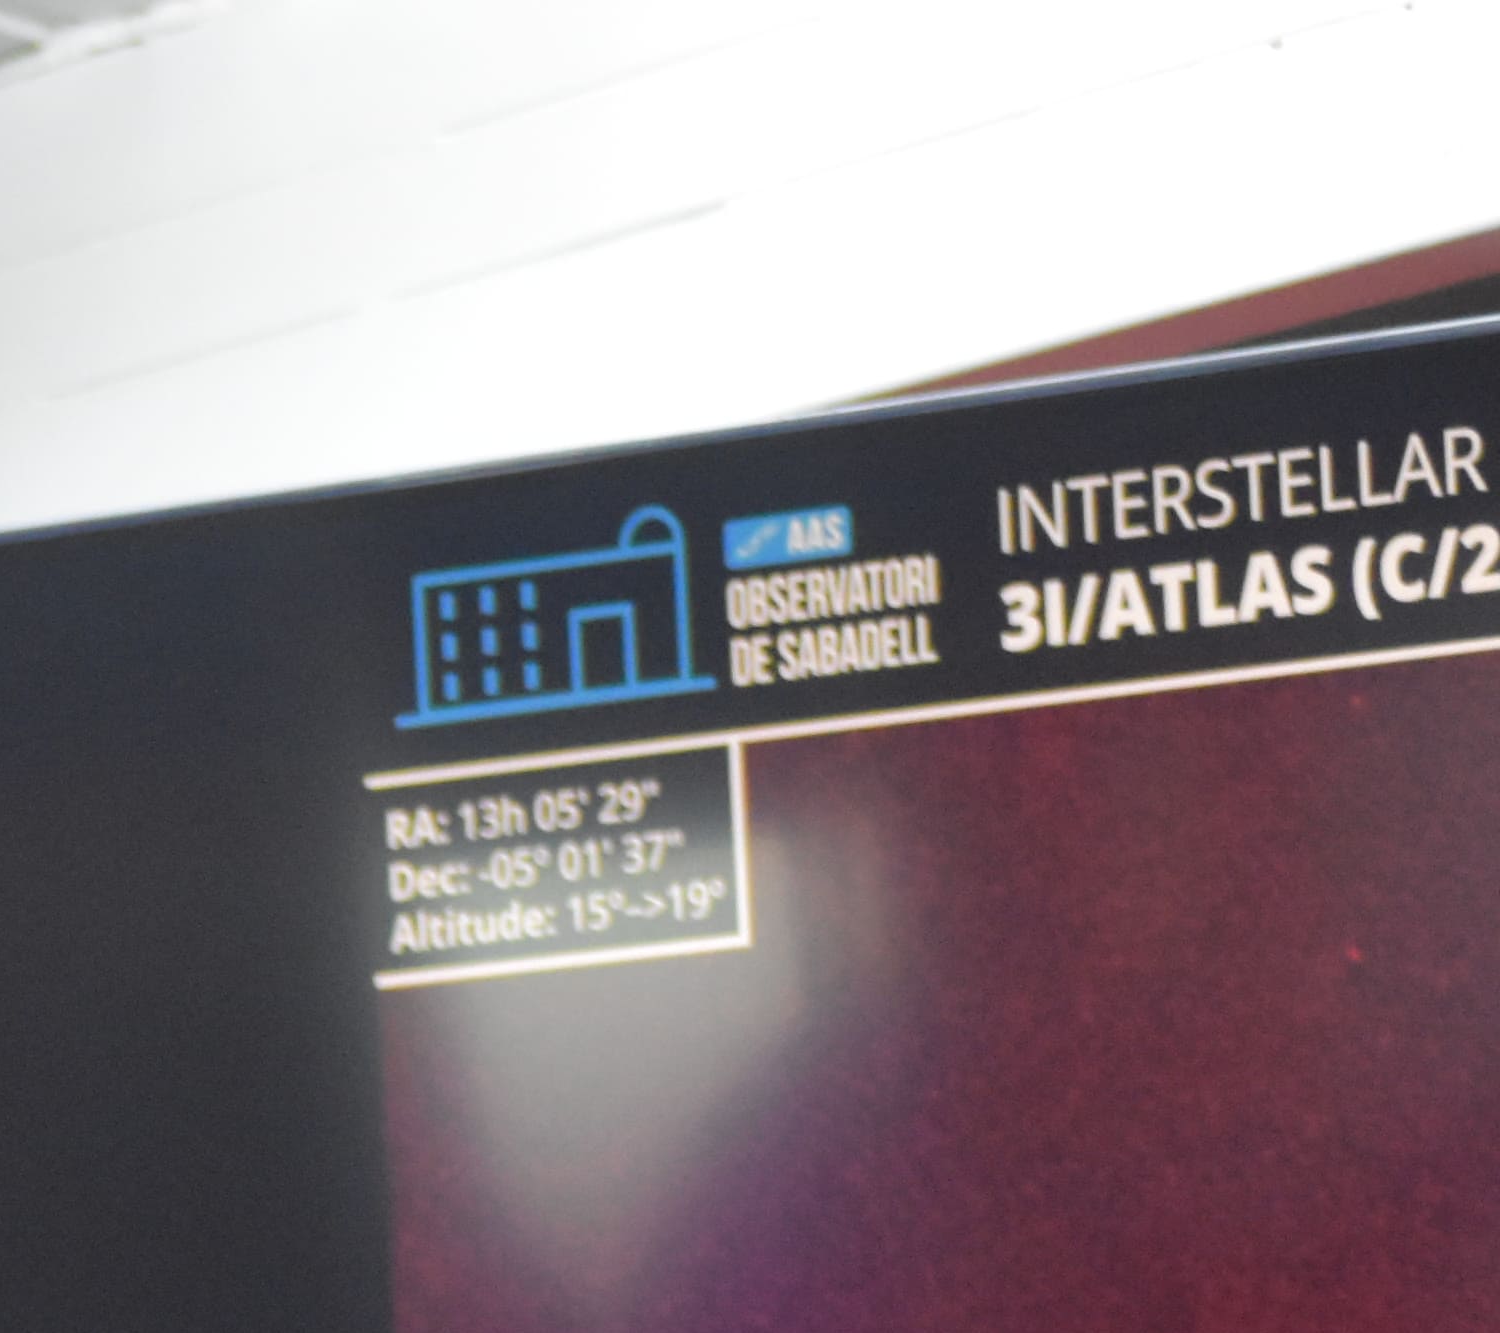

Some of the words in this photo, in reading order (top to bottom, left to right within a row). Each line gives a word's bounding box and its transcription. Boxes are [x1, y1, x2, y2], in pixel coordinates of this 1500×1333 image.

[997, 426, 1489, 556] INTERSTELLAR
[787, 512, 845, 555] AAS
[726, 553, 941, 631] OBSERVATORI
[999, 544, 1335, 654] 3I/ATLAS
[1352, 522, 1500, 621] (C/2
[730, 633, 775, 688] DE
[777, 612, 941, 682] SABADELL
[385, 807, 452, 851] RA:
[458, 794, 530, 841] 13h
[387, 860, 472, 902] Dec:
[478, 844, 551, 890] -05°
[390, 901, 558, 955] Altitude:
